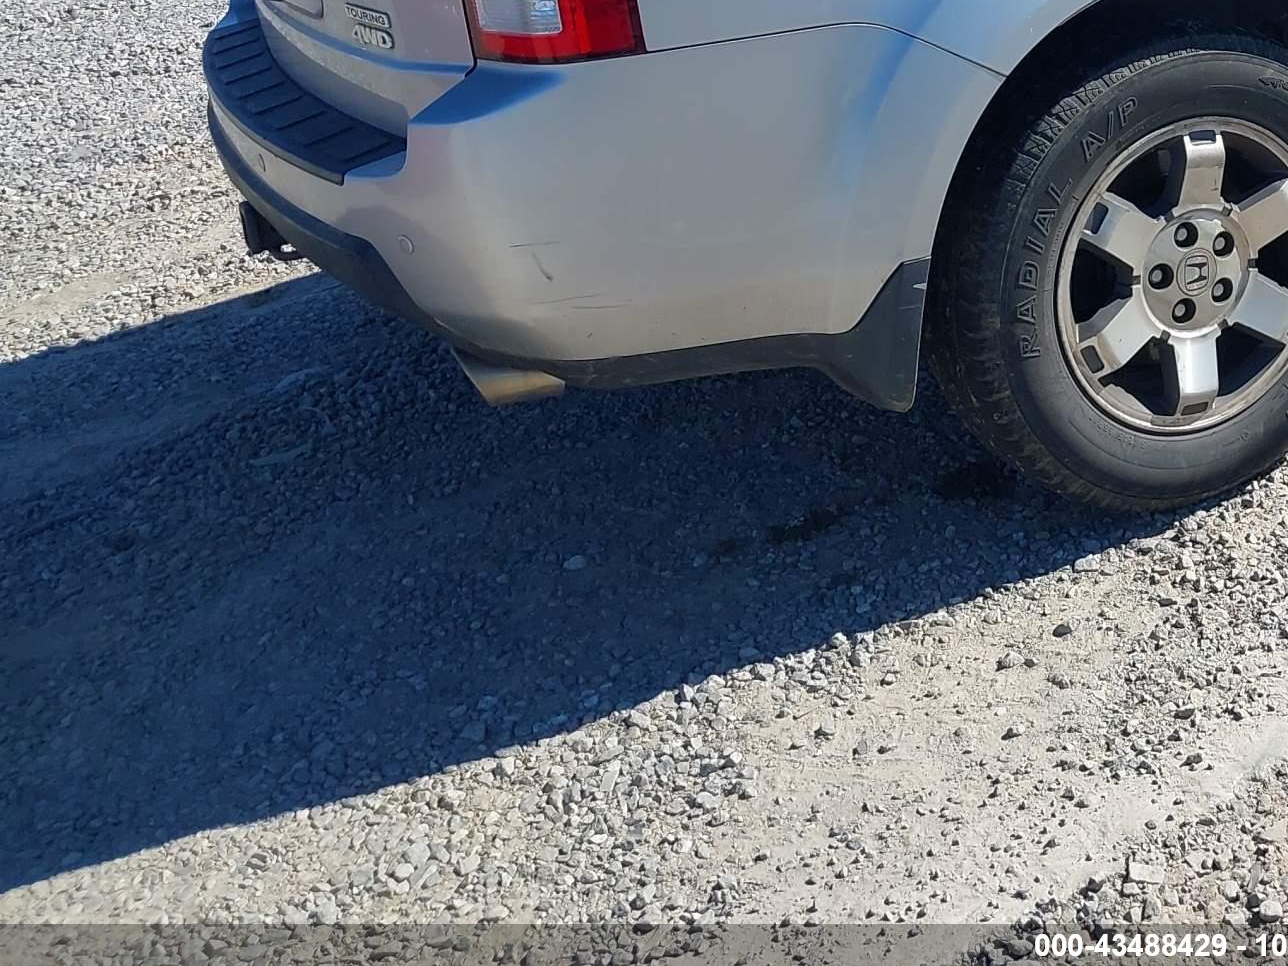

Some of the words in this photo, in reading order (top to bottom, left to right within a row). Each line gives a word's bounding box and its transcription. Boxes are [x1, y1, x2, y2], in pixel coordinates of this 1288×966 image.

[344, 6, 386, 26] TOURING
[352, 23, 394, 49] 4WD
[1016, 177, 1073, 358] RADIAL
[1080, 96, 1138, 163] A/P
